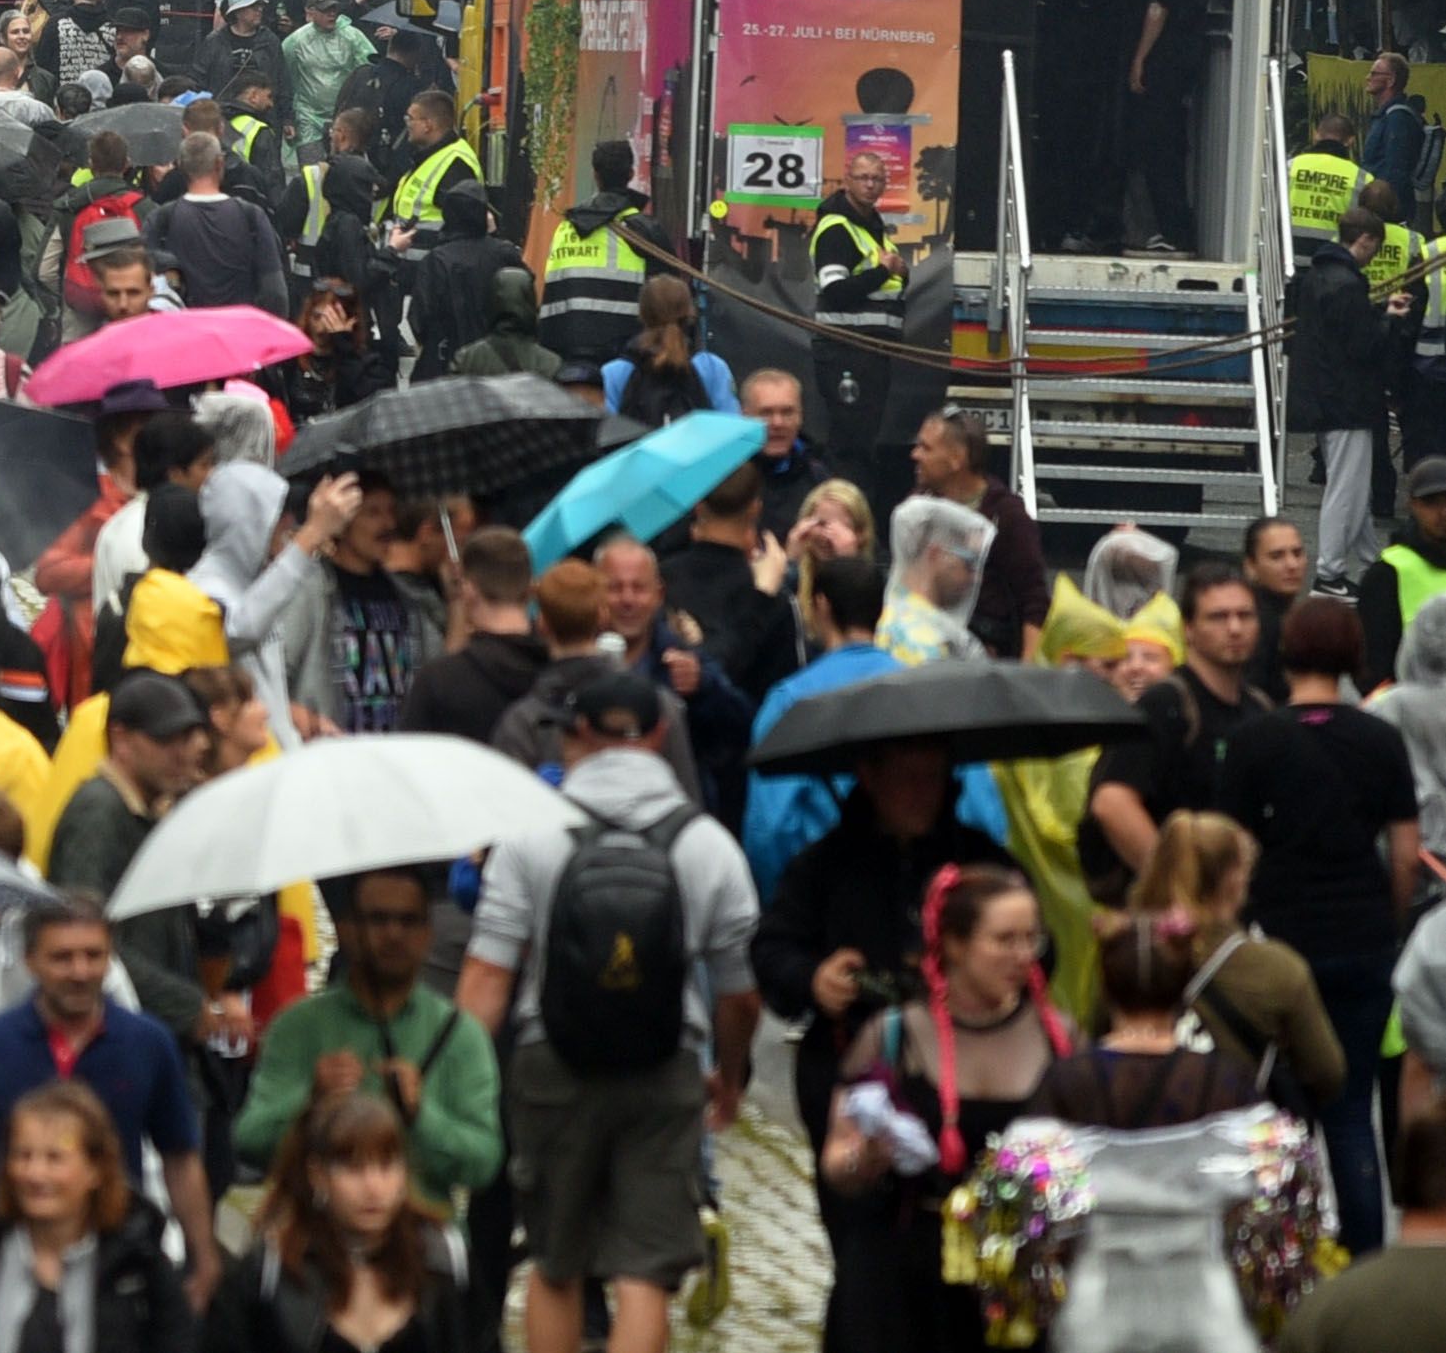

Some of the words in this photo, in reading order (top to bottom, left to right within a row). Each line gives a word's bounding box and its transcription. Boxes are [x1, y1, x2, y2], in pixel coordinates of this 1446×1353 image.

[792, 24, 823, 39] JULI
[835, 28, 856, 40] BEI
[860, 25, 936, 44] NÜRNBERG
[743, 151, 805, 189] 28
[1296, 169, 1350, 190] EMPIRE
[1309, 195, 1329, 206] 167
